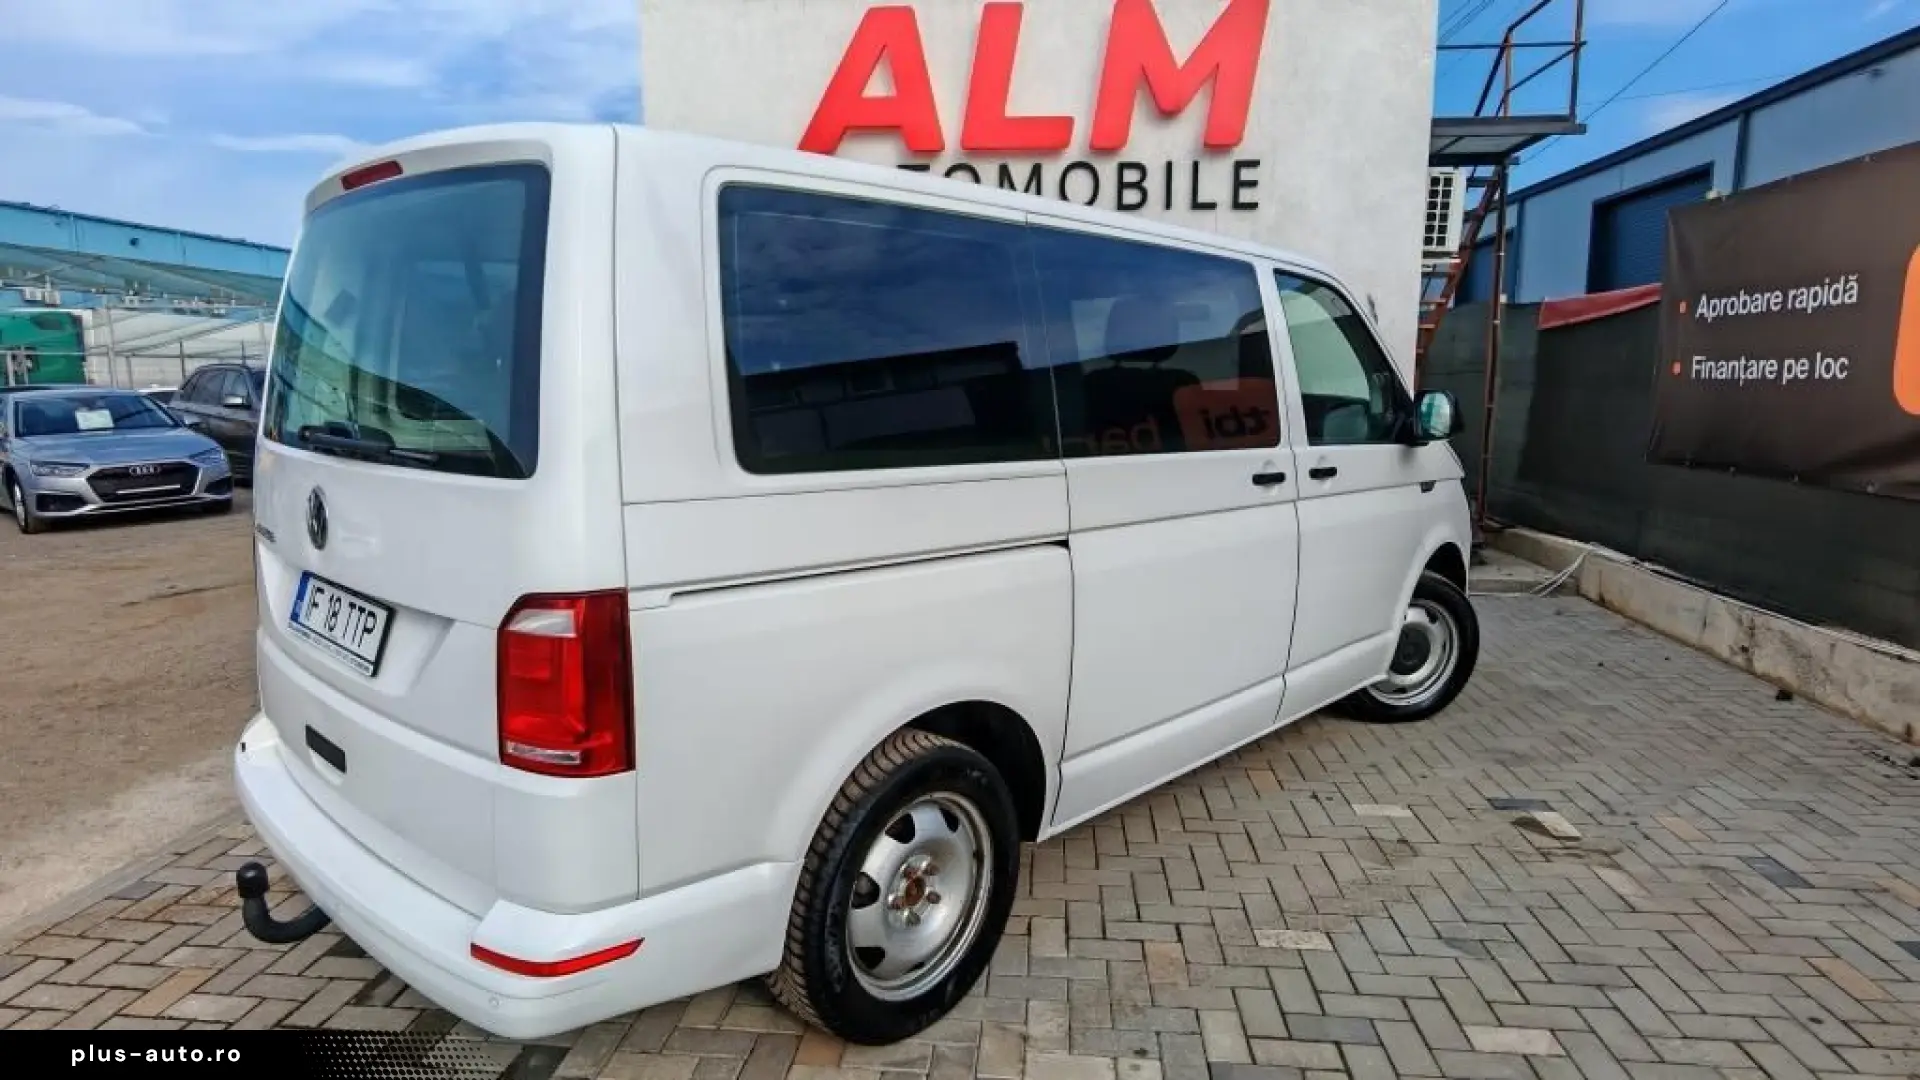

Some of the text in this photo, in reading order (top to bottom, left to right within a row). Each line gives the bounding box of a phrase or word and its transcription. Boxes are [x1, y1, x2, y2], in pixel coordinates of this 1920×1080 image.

[797, 0, 1270, 152] ALM
[896, 160, 1260, 211] MOBILE
[1696, 274, 1859, 322] Aprobare rapidă
[1691, 352, 1848, 386] Finanțare pe loc
[324, 594, 342, 632] 18
[342, 602, 377, 647] TTP
